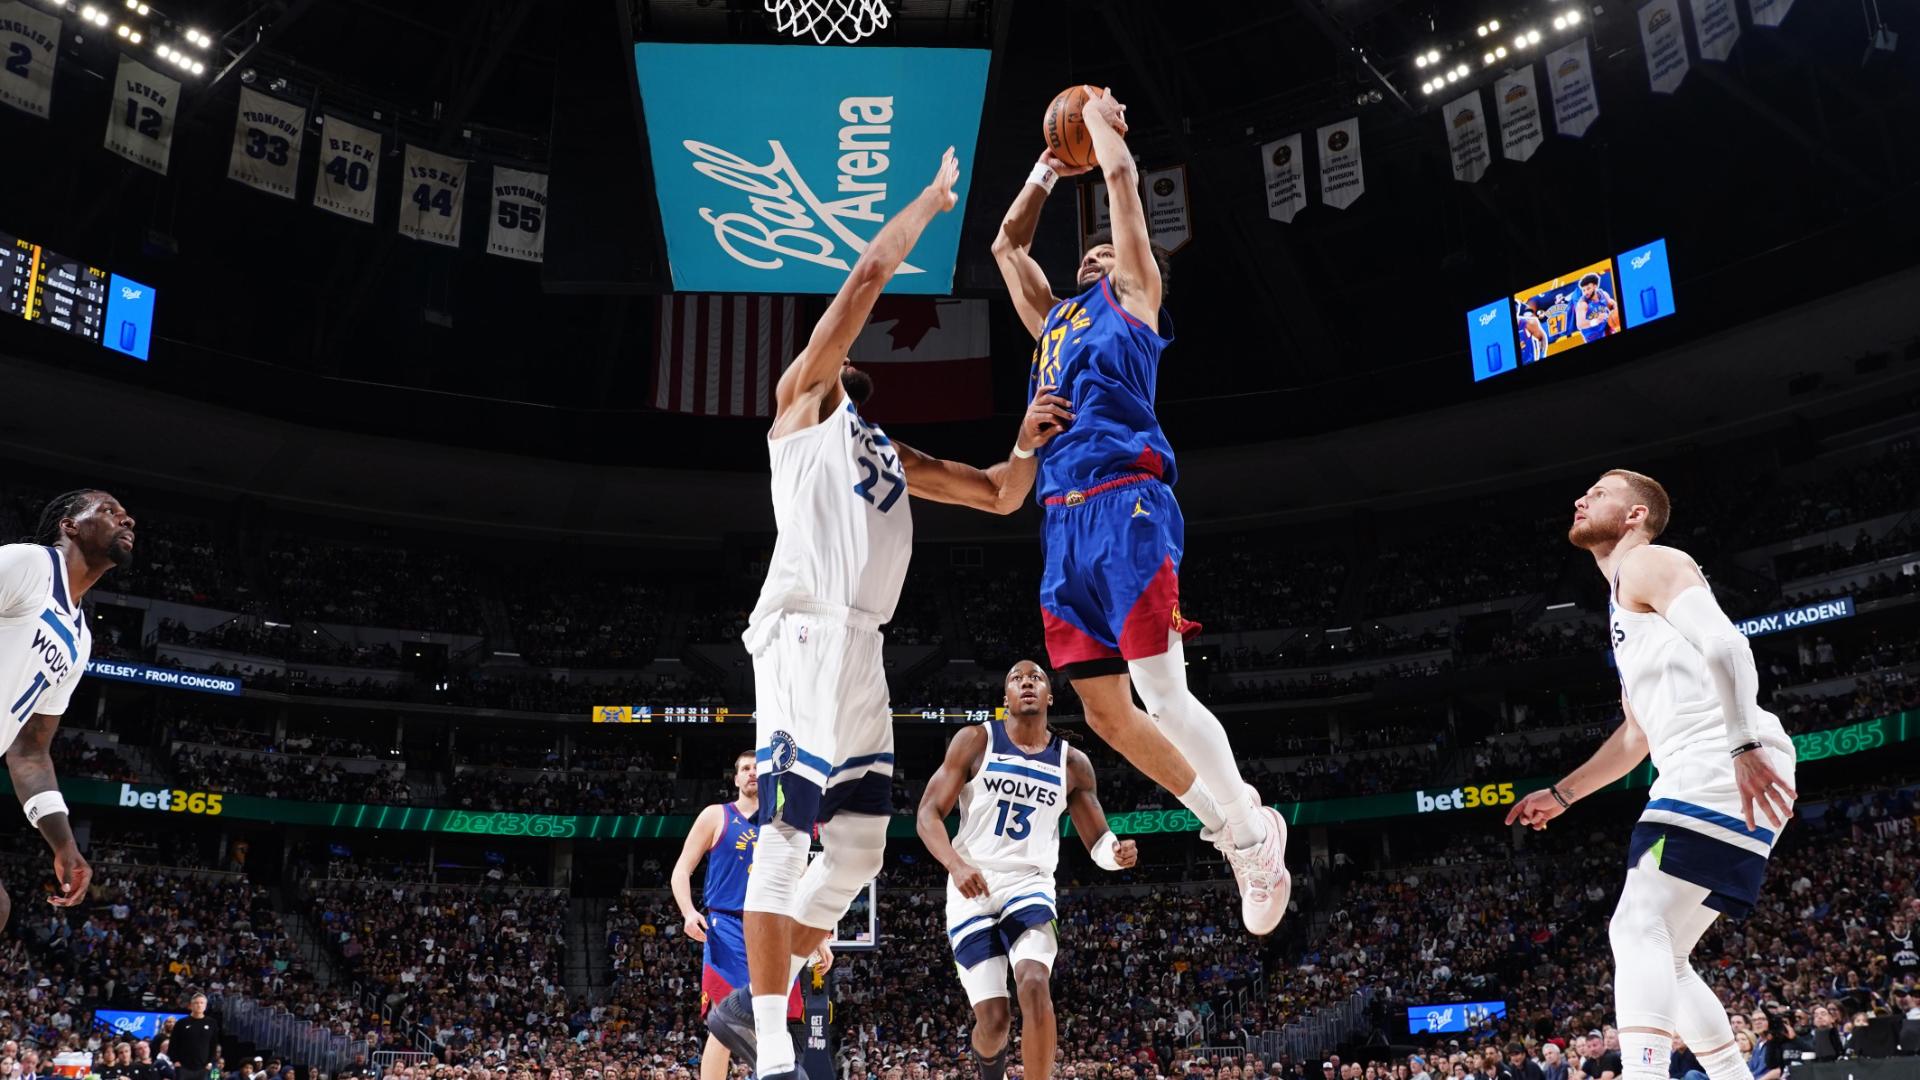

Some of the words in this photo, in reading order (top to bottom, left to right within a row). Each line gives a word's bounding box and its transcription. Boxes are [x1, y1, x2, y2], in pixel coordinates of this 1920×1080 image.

[6, 42, 32, 78] 2
[127, 80, 166, 107] LEVER
[126, 97, 162, 139] 12
[243, 111, 298, 136] THOMPSON
[246, 128, 290, 166] 33
[329, 138, 374, 162] BECK
[822, 96, 894, 222] Arena
[327, 156, 368, 191] 40
[411, 167, 459, 188] ISSEL
[413, 183, 452, 216] 44
[495, 185, 547, 205] MUTOMBO
[683, 139, 880, 272] Ball
[498, 200, 541, 233] 55
[1549, 313, 1566, 336] 27
[854, 456, 905, 513] 27
[1736, 616, 1782, 635] HDAY,
[1785, 601, 1847, 626] KADEN!
[32, 628, 68, 686] WOLVE
[96, 663, 137, 677] KELSEY
[146, 670, 178, 684] FROM
[180, 675, 235, 691] CONCORD
[11, 671, 50, 722] 11
[965, 711, 989, 721] 7:37
[119, 783, 223, 815] bet365
[984, 777, 1057, 807] WOLVES
[1416, 783, 1515, 813] bet365
[443, 809, 576, 838] bet365
[994, 799, 1036, 840] 13
[736, 828, 757, 850] MILE
